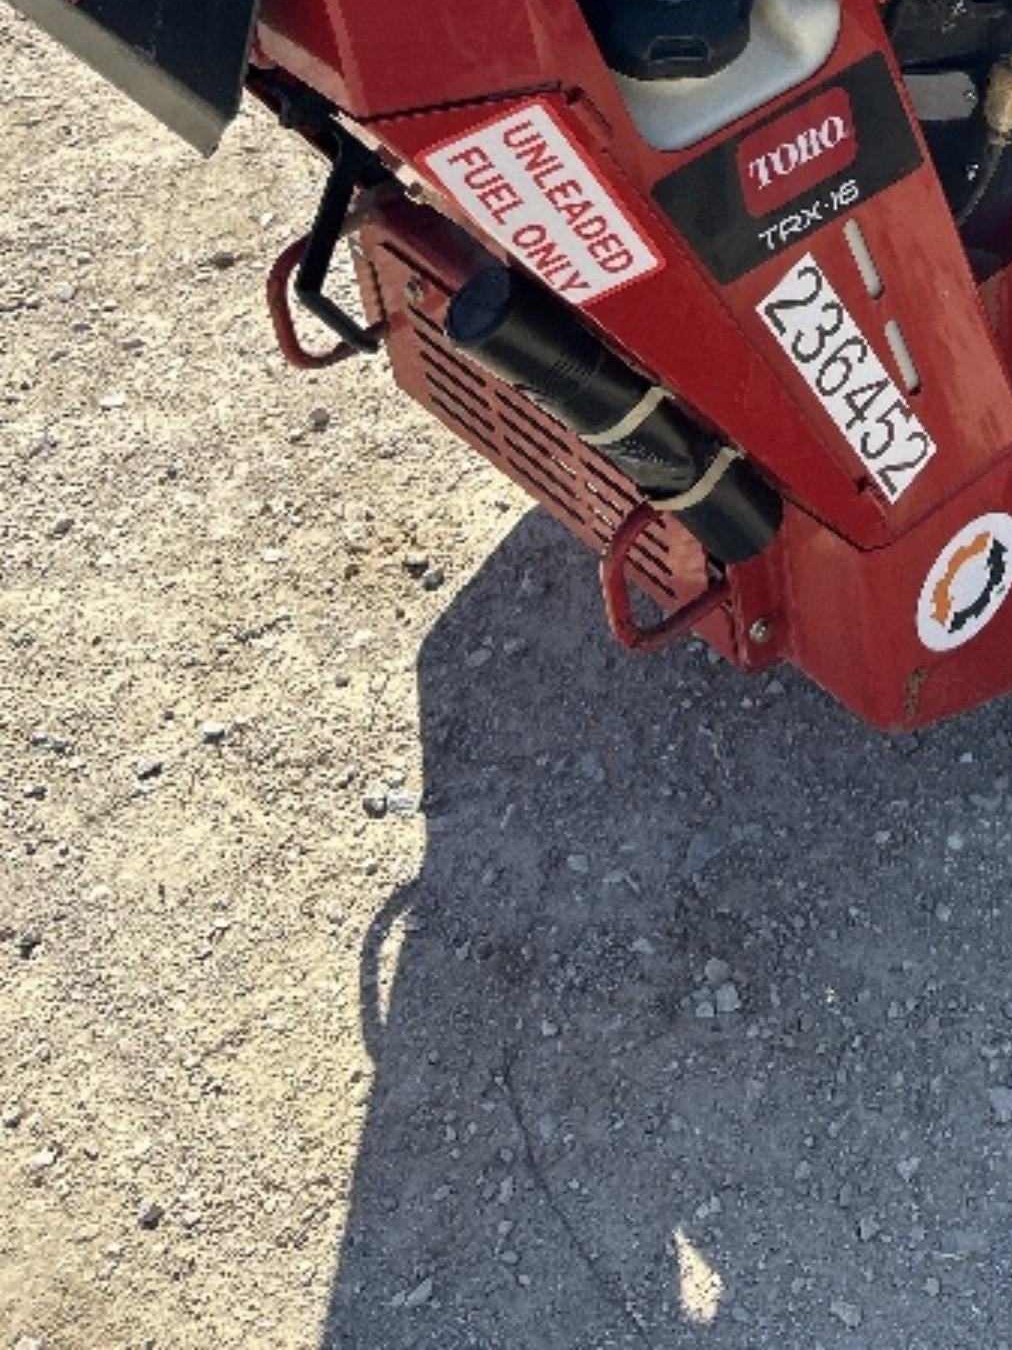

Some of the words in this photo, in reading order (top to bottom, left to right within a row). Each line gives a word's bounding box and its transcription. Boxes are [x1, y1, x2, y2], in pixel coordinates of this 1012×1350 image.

[447, 146, 525, 226] FUEL
[511, 224, 591, 292] ONLY
[502, 120, 634, 274] UNLEADED
[749, 115, 848, 190] TORO
[764, 265, 931, 498] 236452
